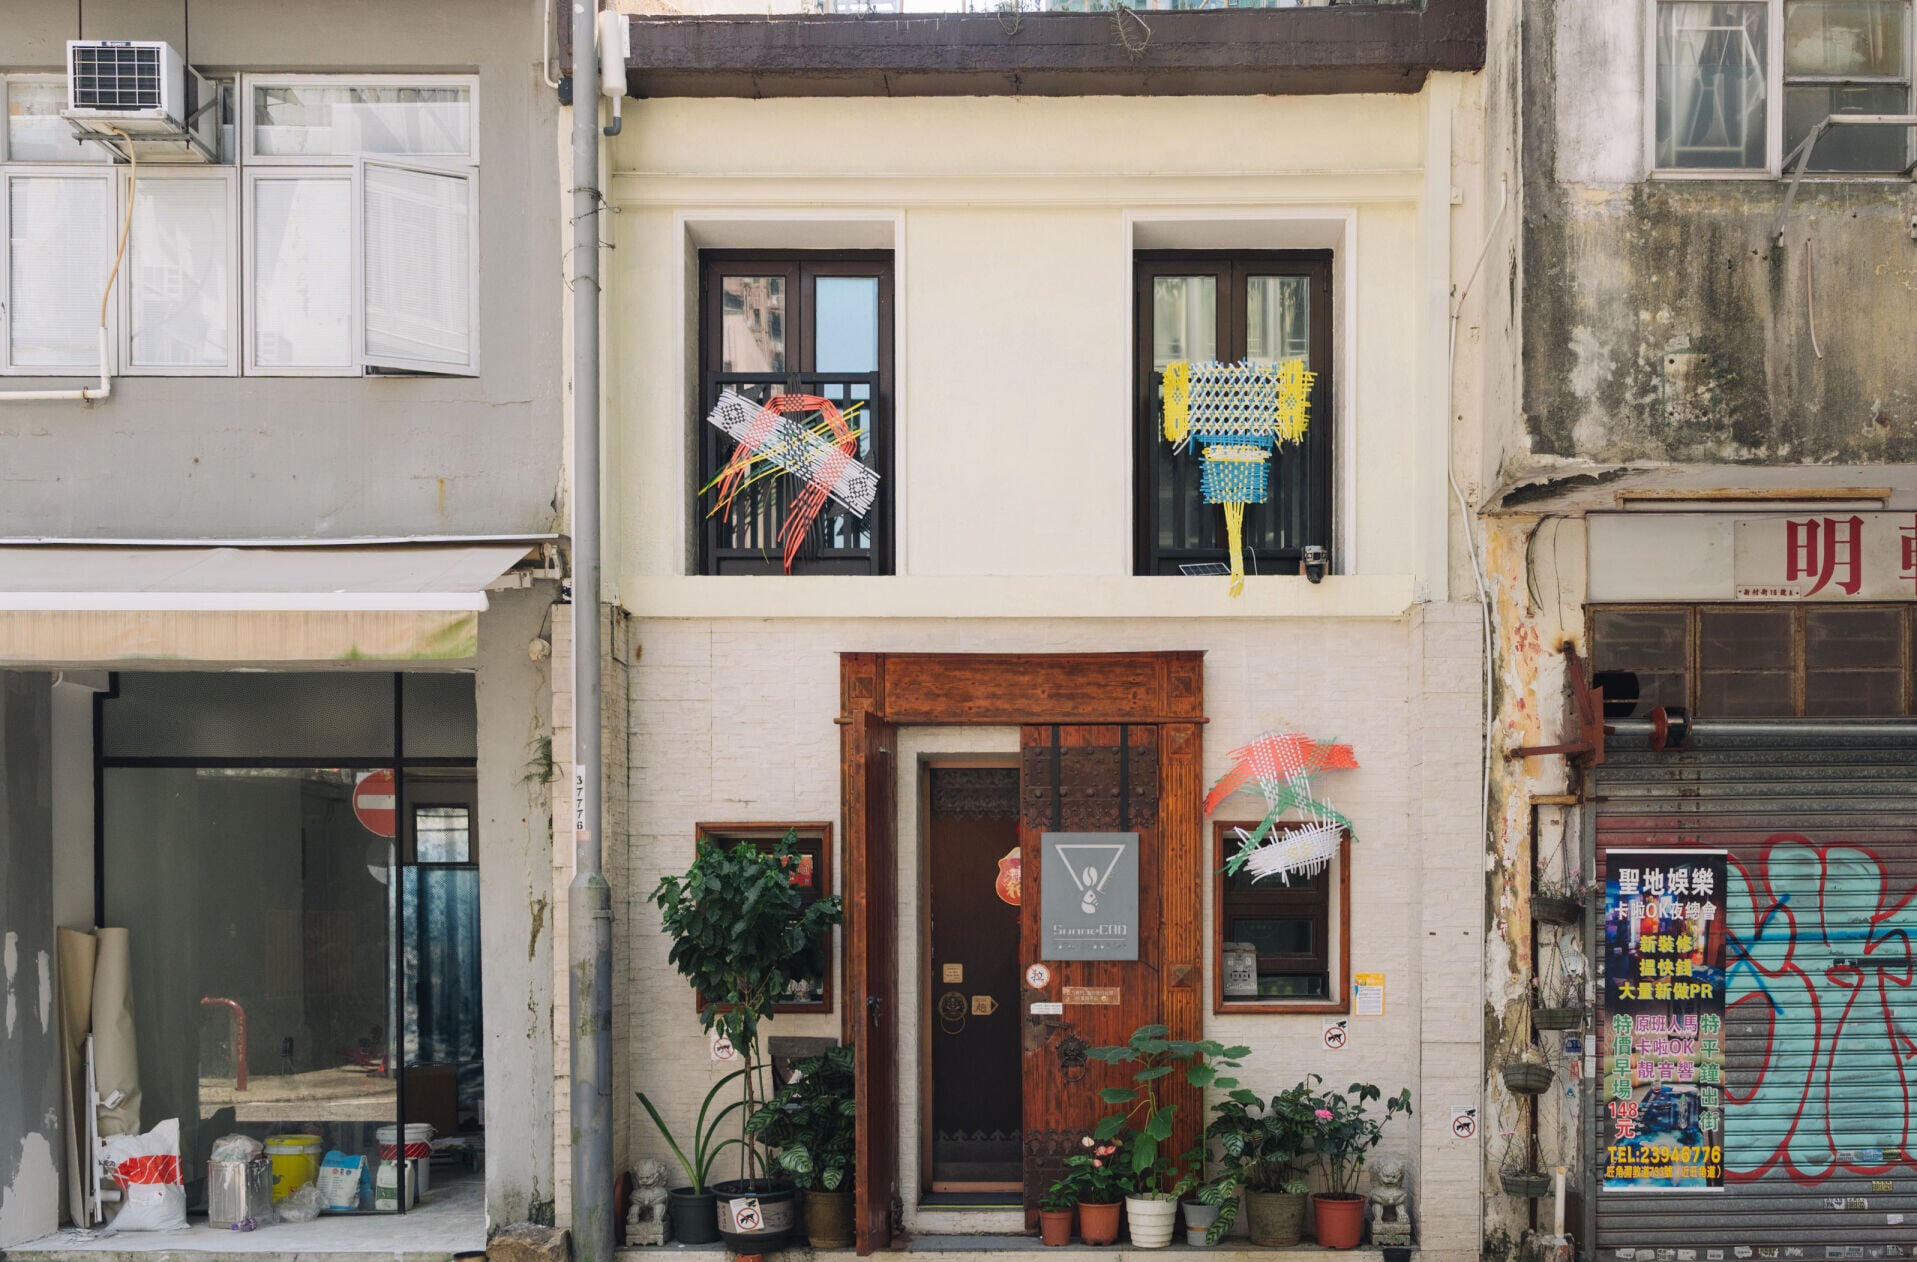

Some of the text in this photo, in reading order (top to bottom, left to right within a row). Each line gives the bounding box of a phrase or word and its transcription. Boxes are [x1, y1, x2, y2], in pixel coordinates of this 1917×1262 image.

[576, 776, 584, 830] 37776
[1618, 867, 1714, 896] 聖地娛樂
[1615, 901, 1717, 920] 卡啦OK夜總會
[1640, 935, 1693, 953] 新裝修
[1639, 958, 1693, 977] 搵快錢
[1635, 1015, 1699, 1034] 原班人馬
[1613, 1014, 1633, 1099] 特價早場
[1636, 1038, 1695, 1057] 卡啦OK
[1637, 1061, 1695, 1080] 靚音響
[1700, 1013, 1721, 1132] 特平鐘出街
[1608, 1102, 1638, 1118] 148
[1615, 1119, 1635, 1138] 元
[1607, 1146, 1722, 1164] TEL:23946776
